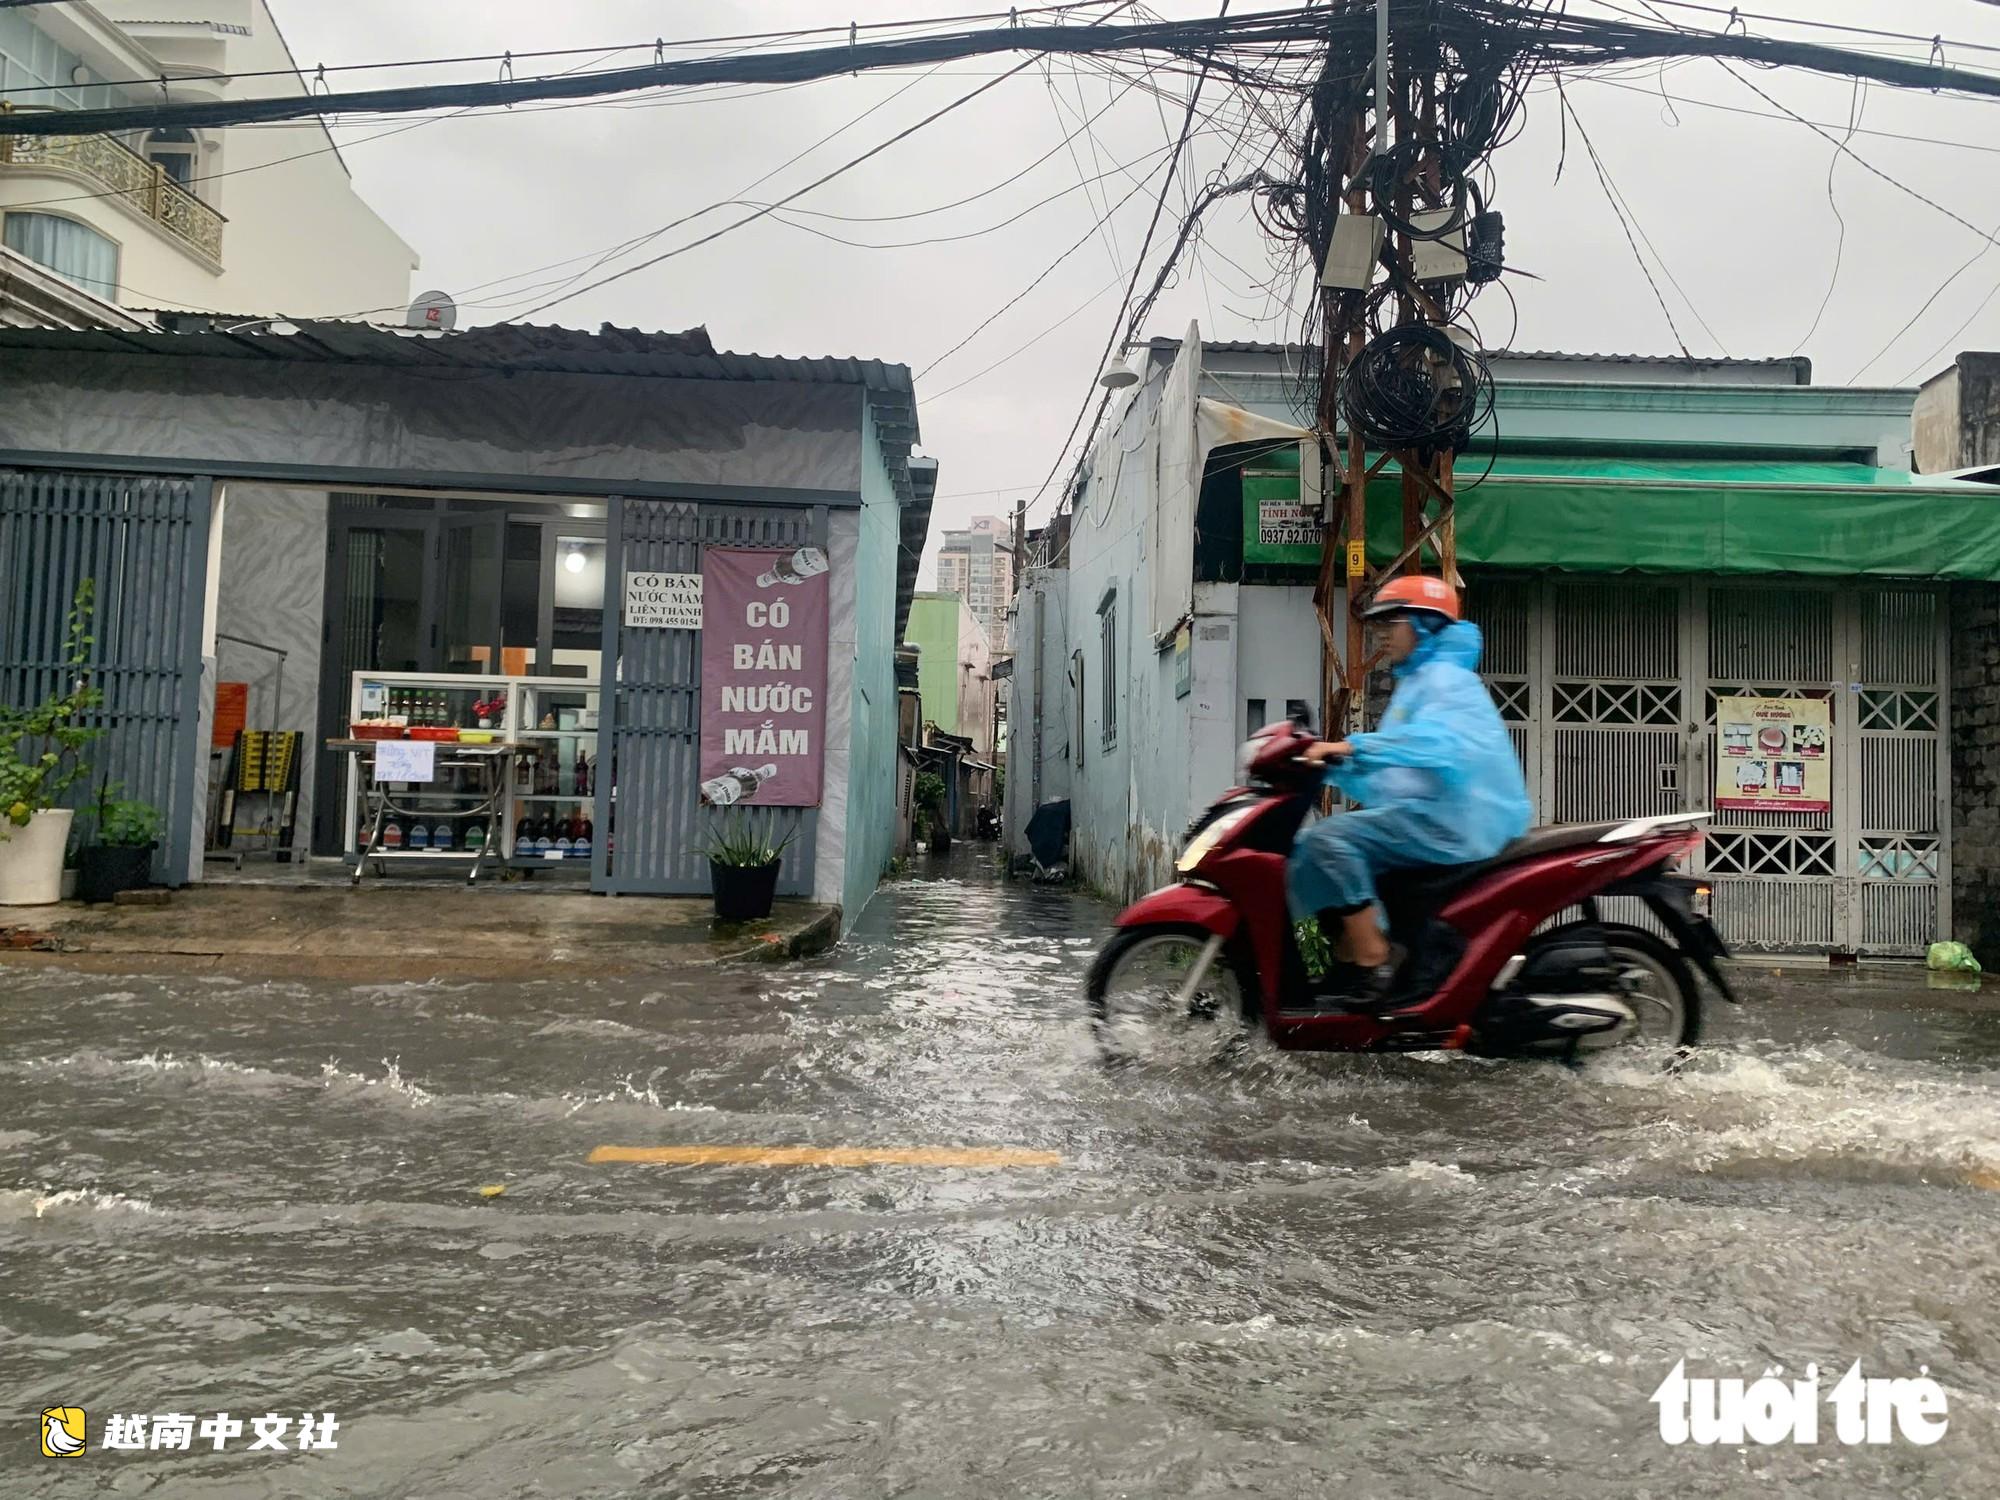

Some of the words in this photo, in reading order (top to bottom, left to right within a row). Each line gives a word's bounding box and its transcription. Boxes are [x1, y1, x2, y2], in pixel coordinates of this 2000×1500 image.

[1352, 553, 1359, 566] 9
[633, 574, 659, 587] CÓ
[664, 575, 700, 589] BÁN
[628, 589, 668, 603] NƯỚC
[629, 604, 658, 614] LIÊN
[746, 595, 790, 628] CÓ
[649, 616, 663, 624] 098
[664, 617, 679, 625] 455
[733, 638, 801, 671] BÁN
[721, 681, 812, 713] NƯỚC
[724, 719, 808, 755] MẮM
